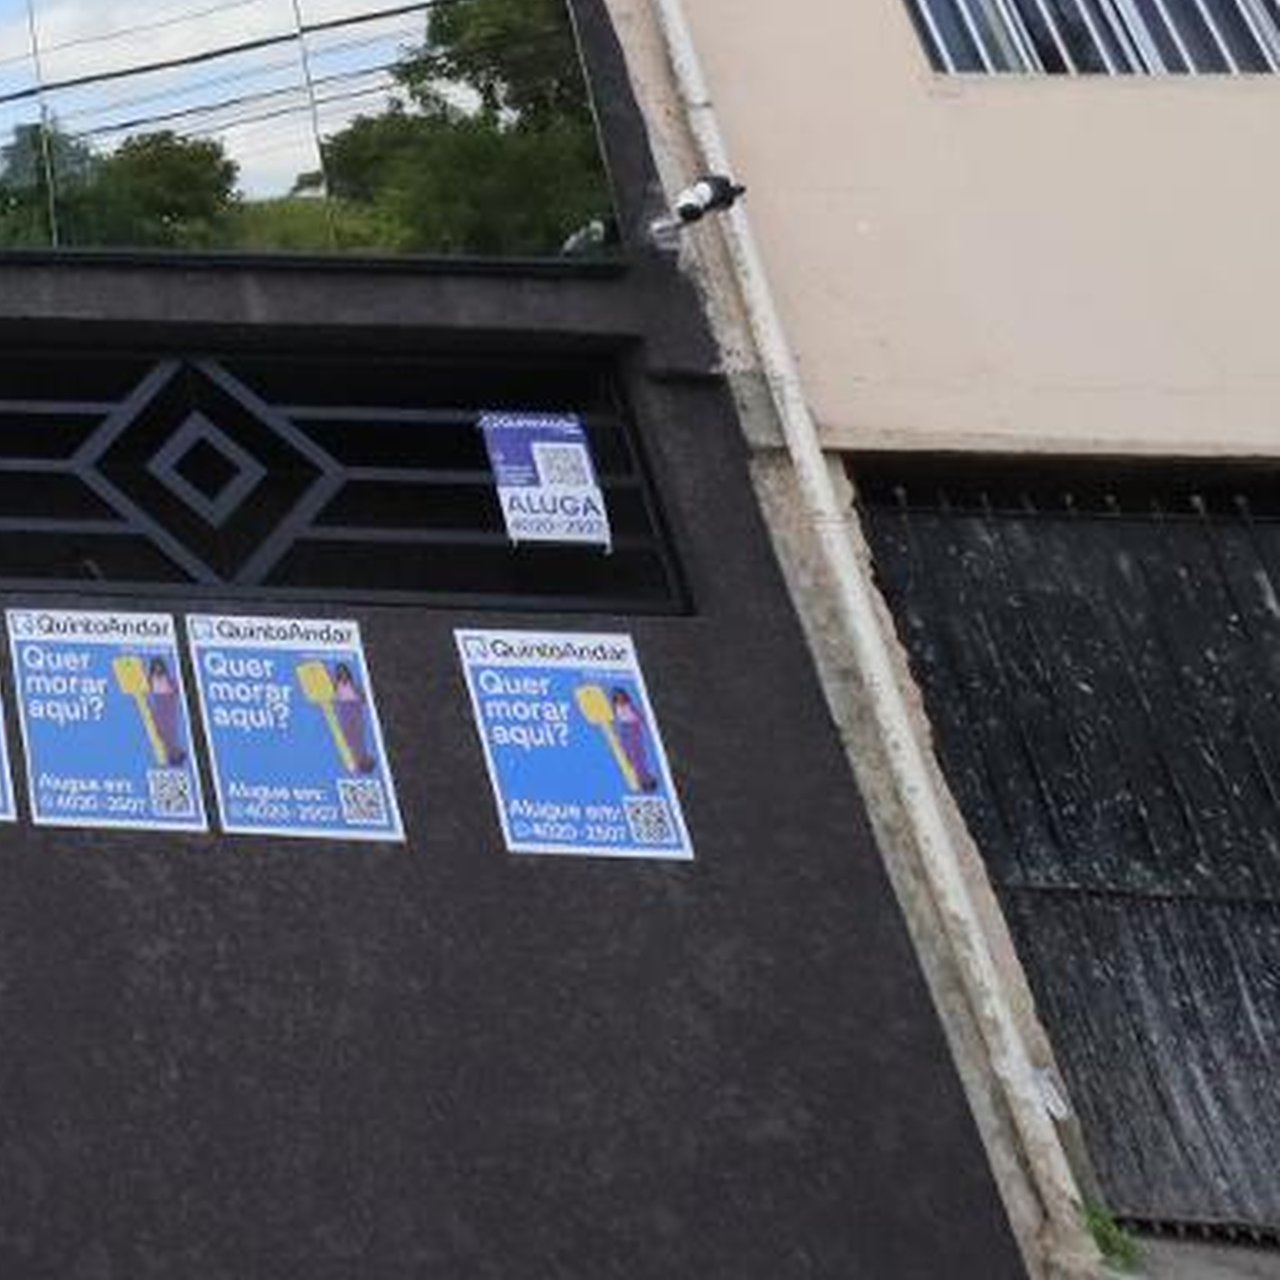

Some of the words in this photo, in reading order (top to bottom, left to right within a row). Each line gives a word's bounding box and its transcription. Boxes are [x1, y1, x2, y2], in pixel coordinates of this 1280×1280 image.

[508, 495, 602, 517] ALUGA
[39, 614, 170, 637] QuintoAndar
[216, 620, 353, 643] QuintoAndar
[22, 645, 91, 671] Quer
[491, 638, 628, 662] QuintoAndar
[204, 652, 274, 679] Quer
[26, 674, 107, 696] morar
[209, 681, 293, 703] morar
[480, 670, 551, 696] Quer
[30, 698, 105, 726] aqui?
[214, 704, 290, 731] aqui?
[485, 702, 570, 721] morar
[493, 723, 569, 750] aqui?
